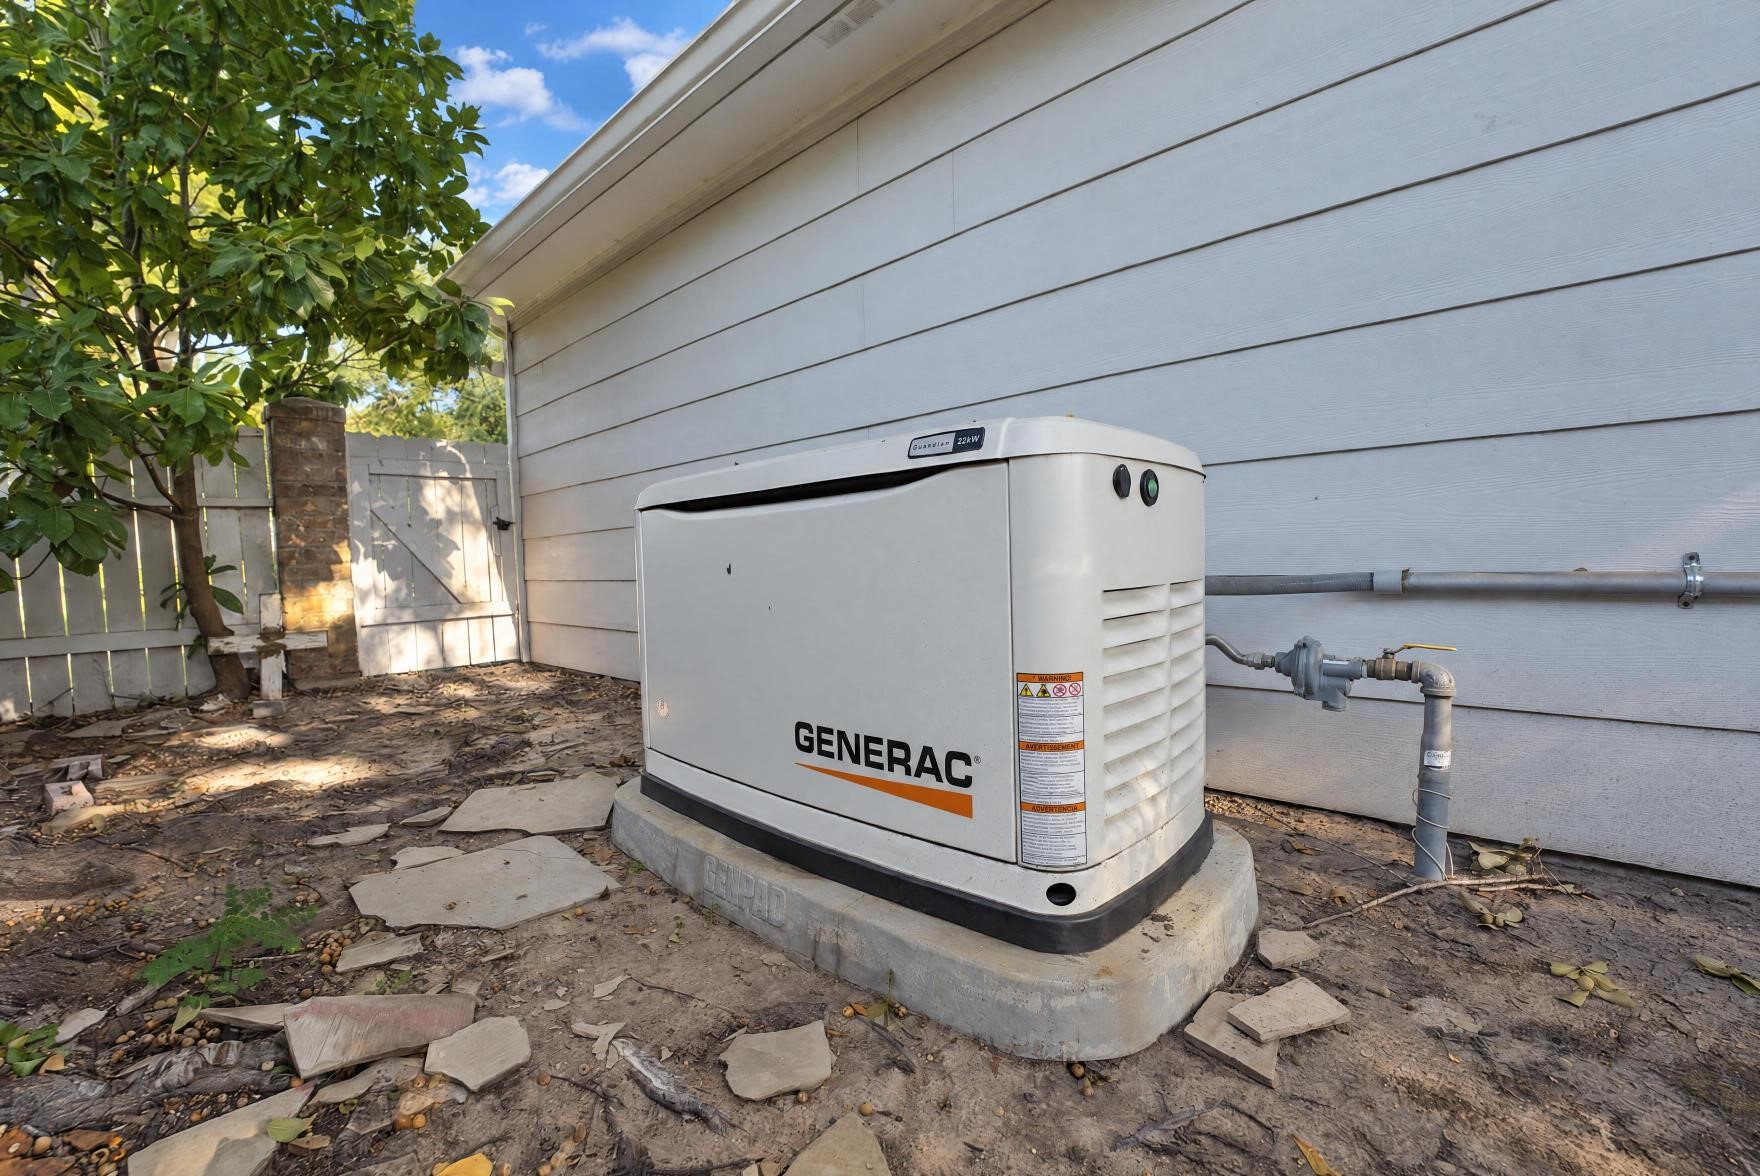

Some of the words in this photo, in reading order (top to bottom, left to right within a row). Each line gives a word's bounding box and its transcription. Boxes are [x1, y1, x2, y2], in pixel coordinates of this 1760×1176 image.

[912, 441, 950, 451] Guardian
[957, 434, 980, 445] 22kW
[794, 720, 973, 789] GENERAC
[1025, 742, 1080, 751] AVERTISSEMENT
[1031, 804, 1078, 813] ADVERTENCIA
[704, 855, 788, 929] GENPAD
